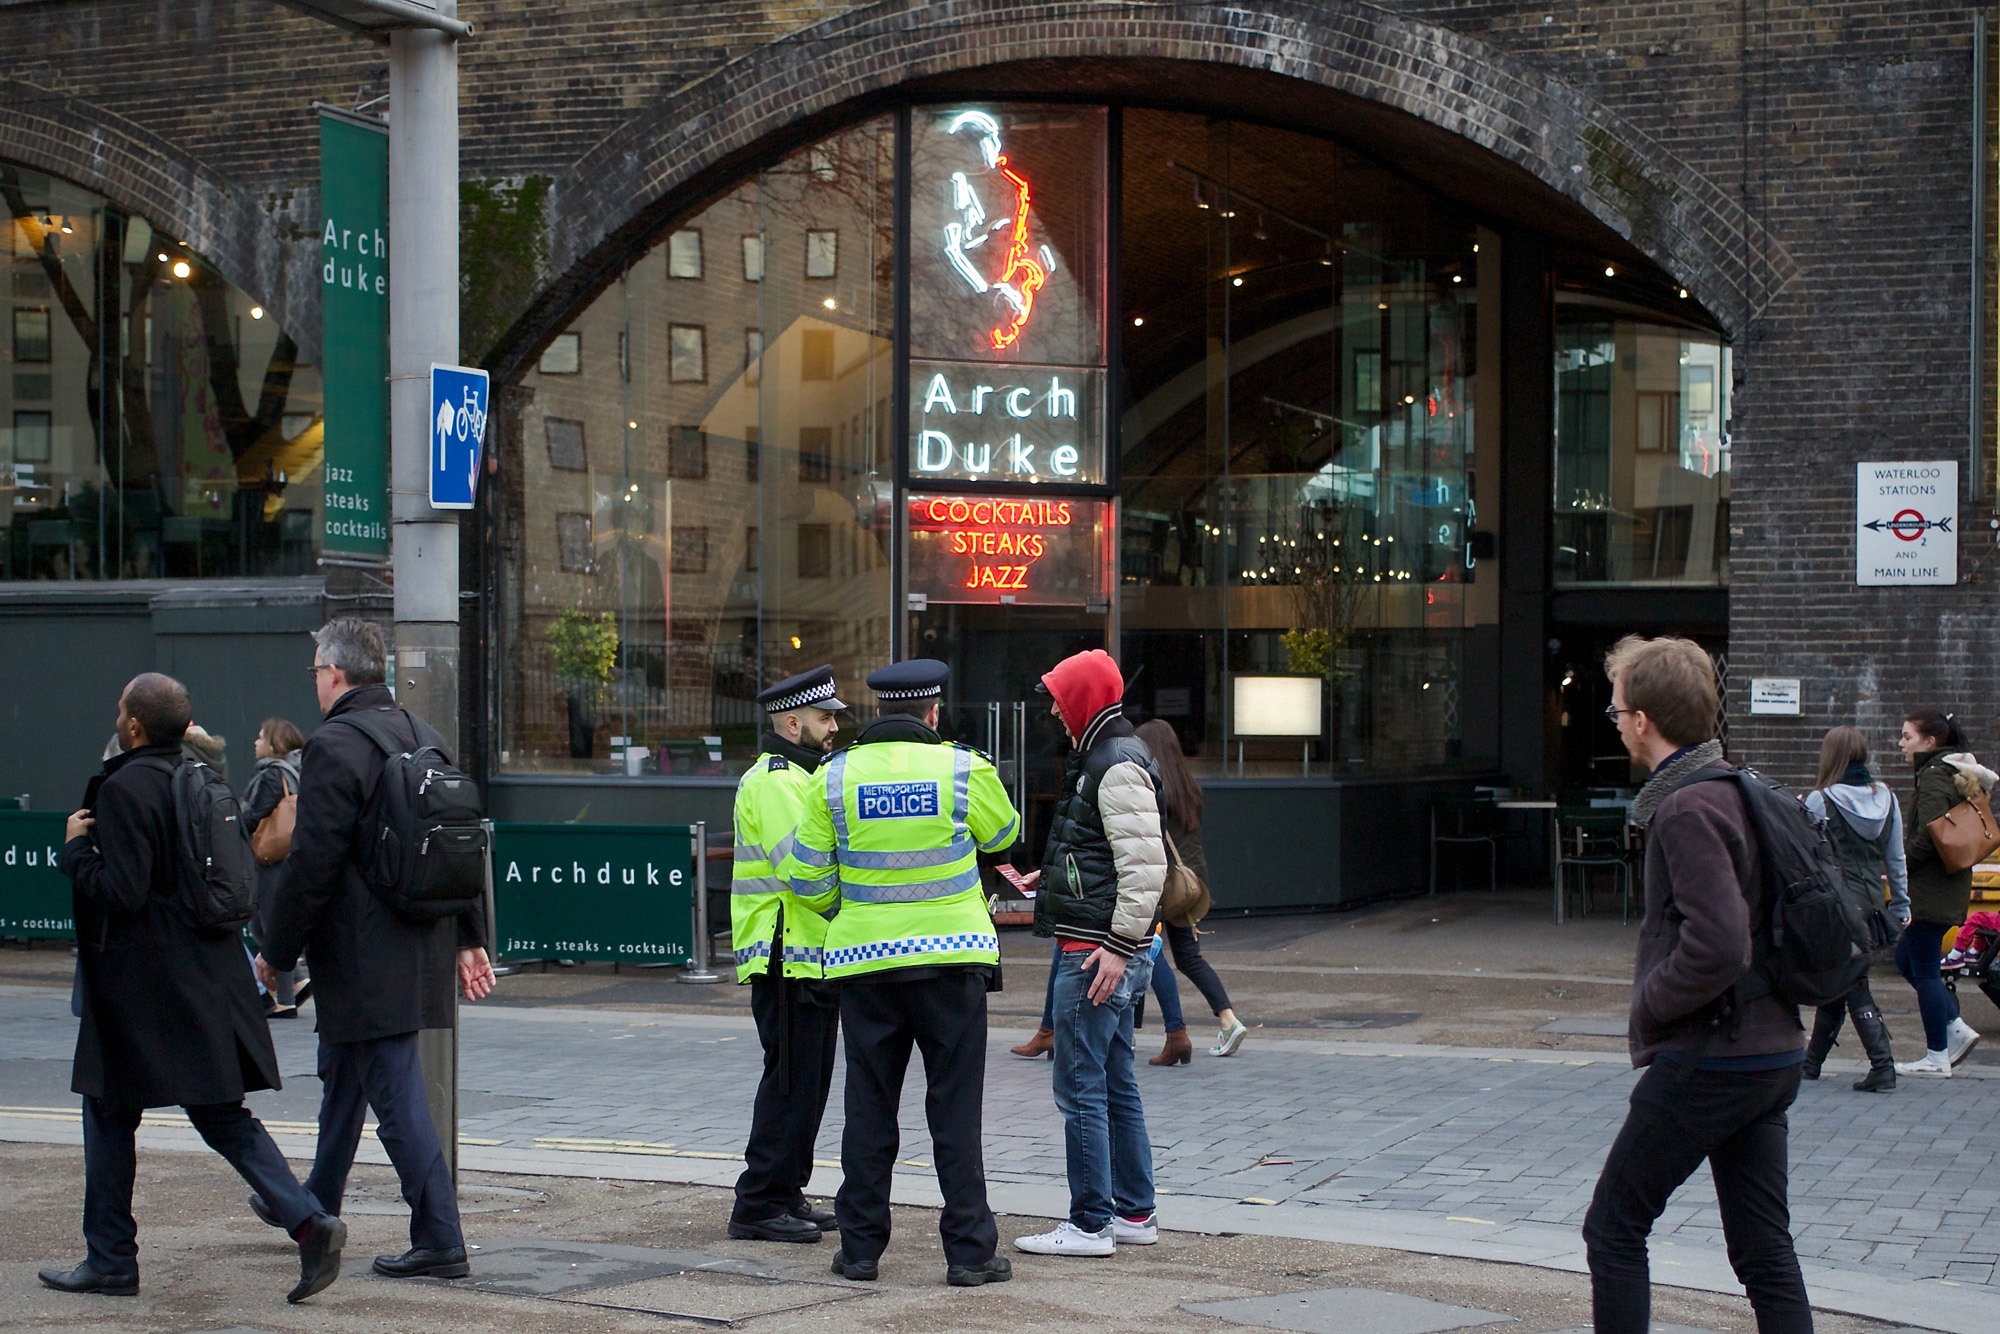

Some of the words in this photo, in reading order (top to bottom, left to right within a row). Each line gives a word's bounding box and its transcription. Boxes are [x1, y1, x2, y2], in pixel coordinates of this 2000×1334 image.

[323, 218, 385, 258] Arch
[323, 256, 385, 295] duke
[924, 372, 1077, 418] Arch
[918, 429, 1079, 476] Duke
[325, 463, 353, 483] jazz
[1874, 468, 1940, 479] WATERLOO
[1879, 485, 1936, 496] STATIONS
[325, 492, 369, 511] steaks
[928, 498, 1072, 526] COCKTAILS
[325, 519, 387, 540] cocktails
[953, 531, 1044, 557] STEAKS
[1920, 537, 1927, 546] 2
[966, 565, 1029, 589] JAZZ
[1874, 568, 1906, 578] MAIN
[1912, 567, 1939, 577] LINE
[863, 784, 933, 796] METROPOLITAN
[864, 794, 933, 816] POLICE
[506, 861, 683, 886] Archduke
[22, 918, 76, 930] cocktail
[507, 937, 536, 951] jazz
[555, 940, 599, 952] steaks
[618, 942, 684, 955] cocktails
